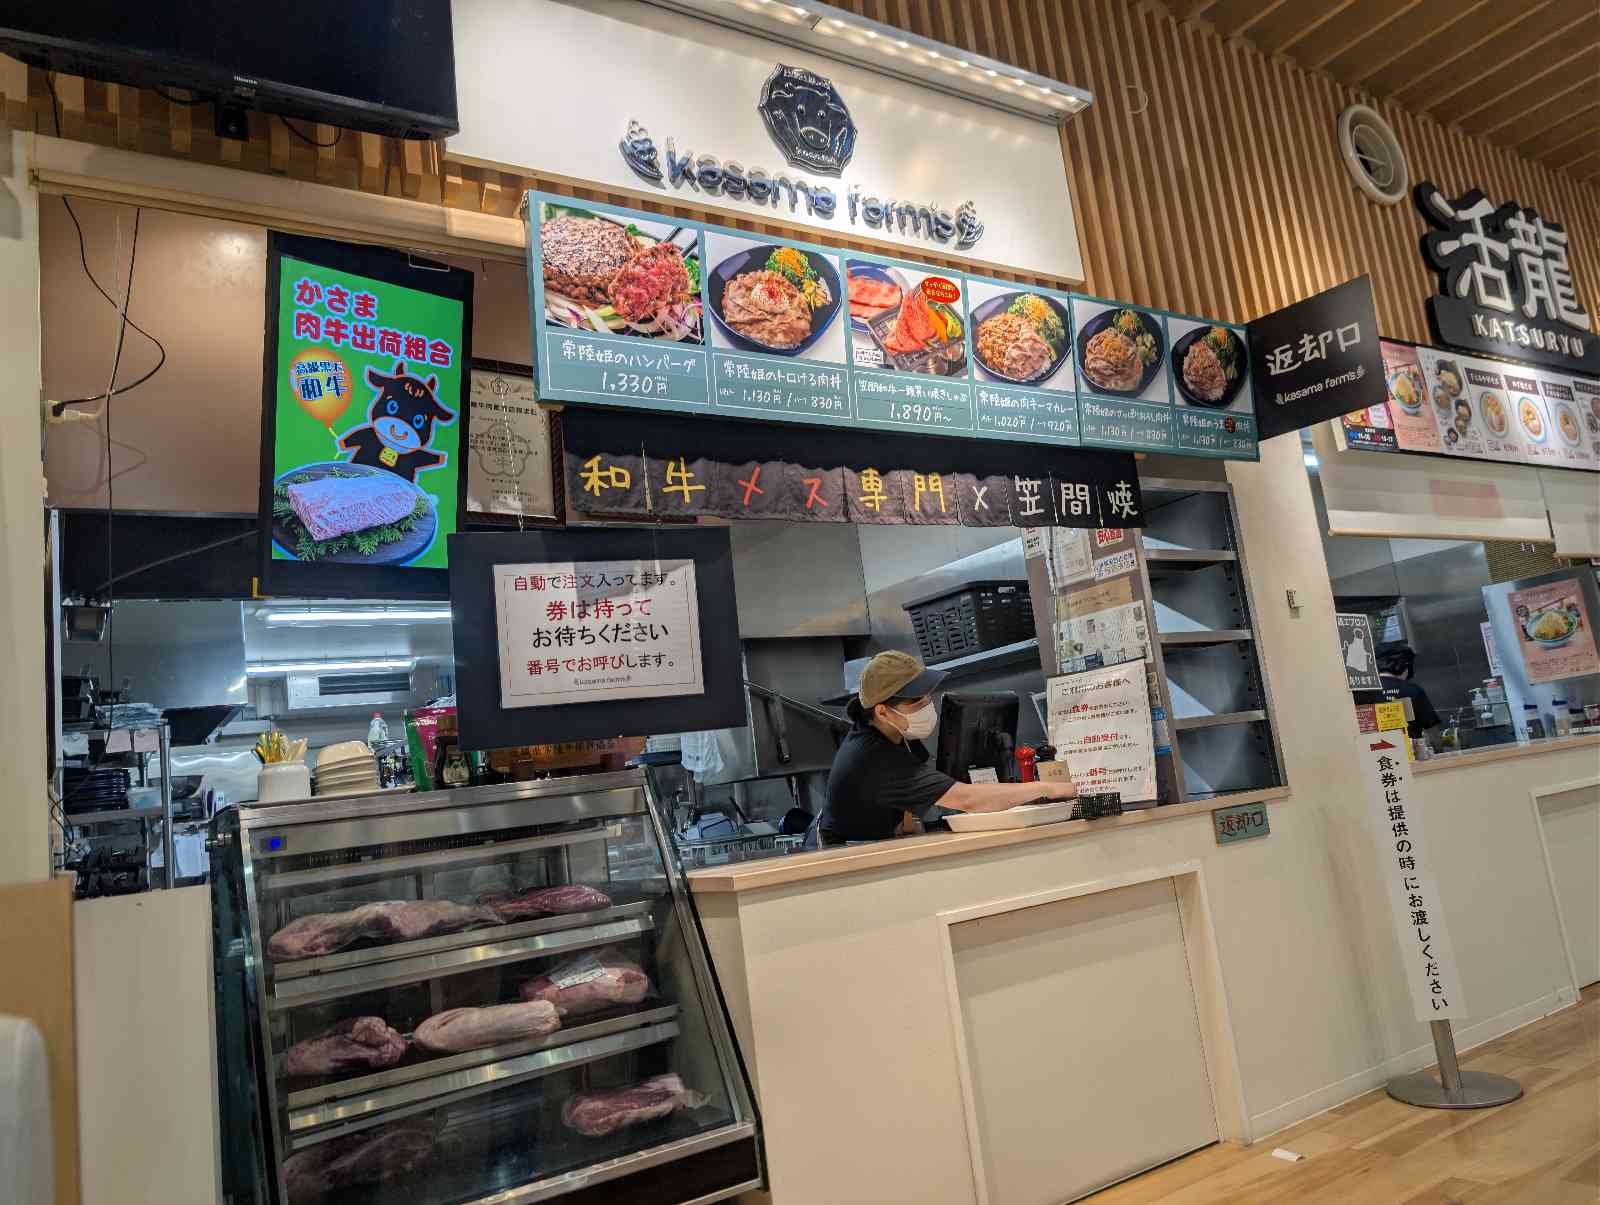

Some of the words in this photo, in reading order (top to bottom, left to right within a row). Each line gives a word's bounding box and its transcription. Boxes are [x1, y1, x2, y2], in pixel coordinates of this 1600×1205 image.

[667, 136, 837, 220] kasama
[1430, 190, 1591, 332] 活龍
[295, 279, 376, 319] かさま
[294, 312, 452, 366] 肉牛出荷組合
[1264, 322, 1361, 376] 返却口
[1472, 314, 1585, 357] KATSURYU
[300, 375, 348, 400] 和牛
[1284, 382, 1323, 402] kasama
[513, 571, 677, 593] 自動で注文入ってます。
[545, 597, 653, 622] 券は持って
[532, 622, 669, 649] お待ちください
[526, 651, 675, 677] 番号でお呼びします。
[1376, 755, 1449, 1012] 食券は提供の時にお渡しください
